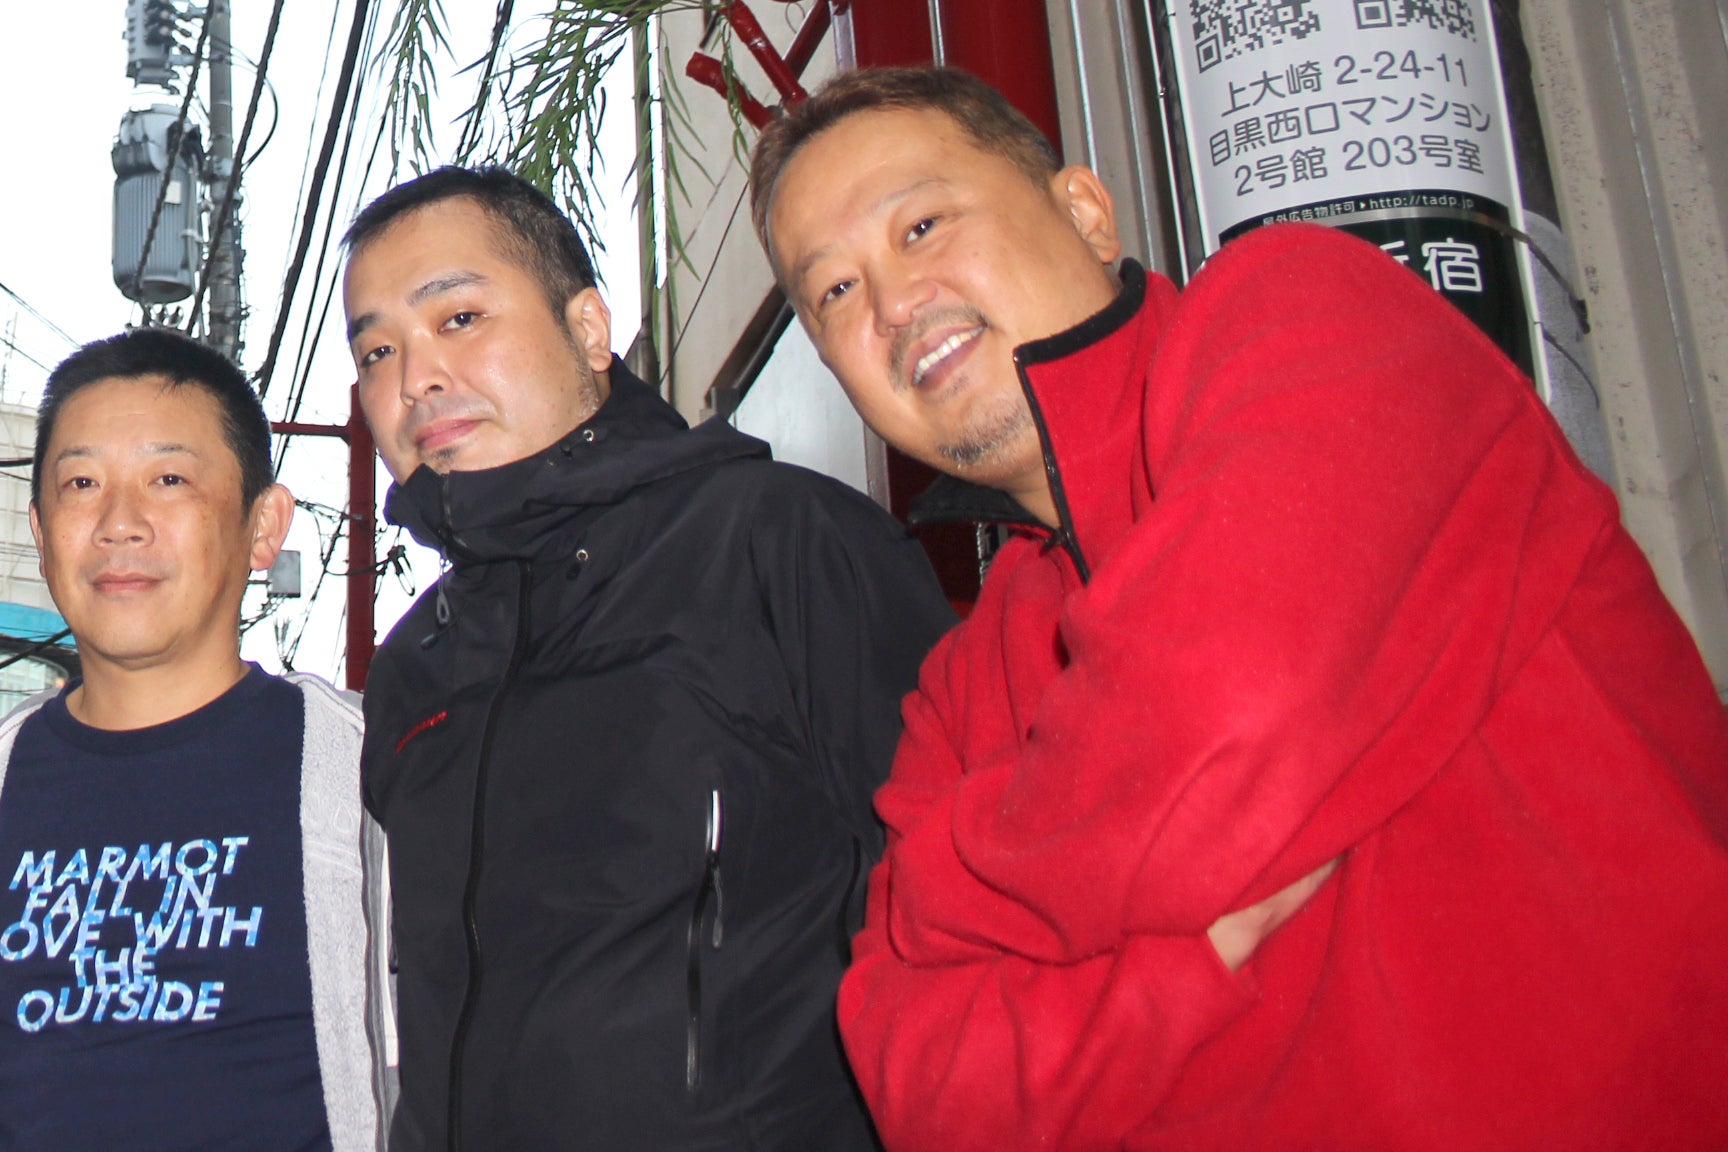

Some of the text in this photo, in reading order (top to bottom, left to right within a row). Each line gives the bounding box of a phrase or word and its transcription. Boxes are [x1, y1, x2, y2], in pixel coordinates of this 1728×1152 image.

[1219, 50, 1468, 118] 上大崎 2-24-11
[1208, 92, 1493, 167] 目黒西口マンション
[1234, 136, 1486, 197] 2号館 203号室
[1369, 193, 1475, 211] http://tadp.jp
[1378, 238, 1483, 292] 宿
[8, 835, 250, 891] MARMOT
[20, 871, 218, 928] FALL IN
[133, 905, 263, 950] WITH
[68, 946, 157, 989] THE
[16, 980, 226, 1033] OUTSIDE
